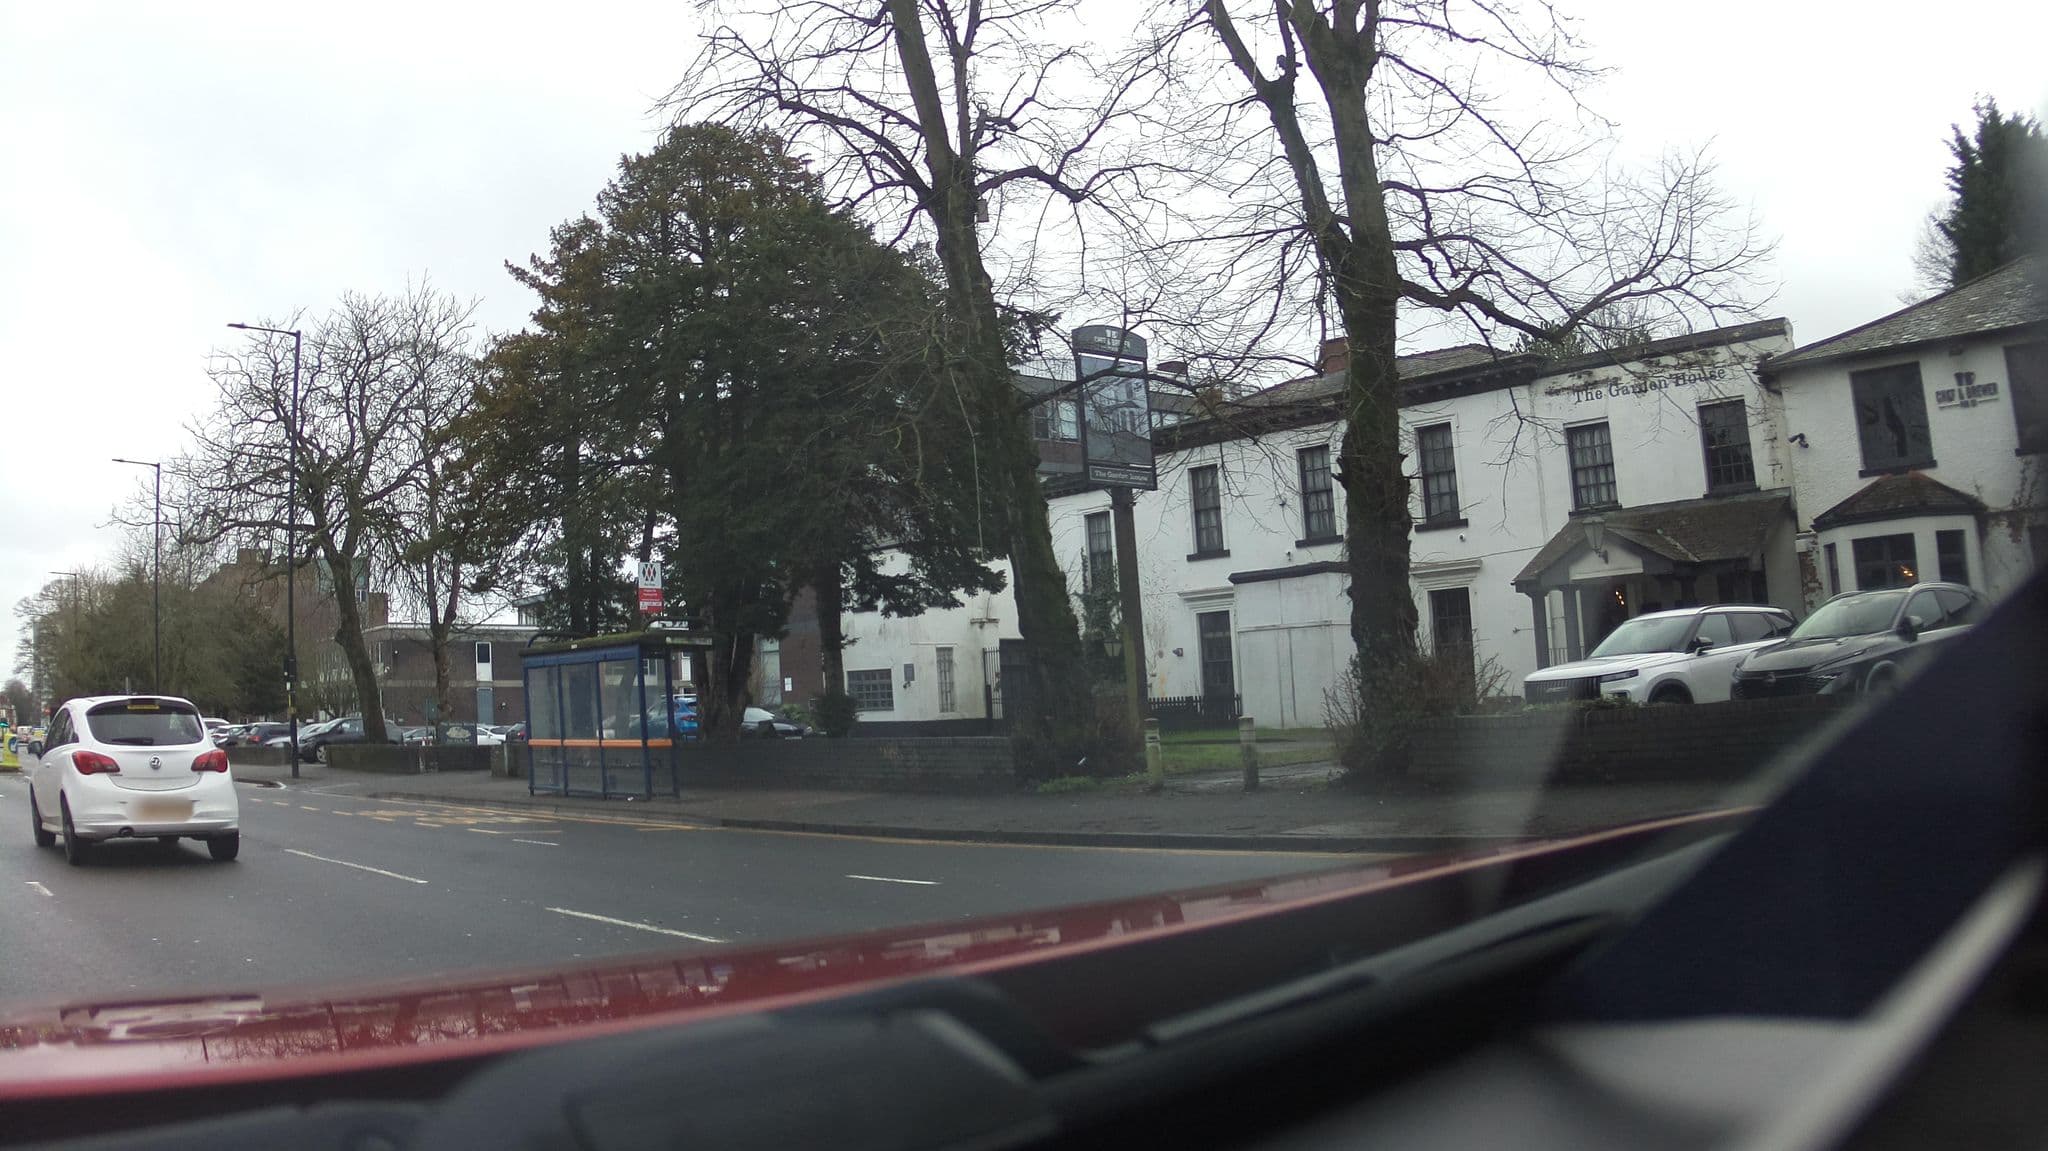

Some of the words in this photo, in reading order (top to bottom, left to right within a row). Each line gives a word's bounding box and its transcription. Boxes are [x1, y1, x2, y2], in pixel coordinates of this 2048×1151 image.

[1573, 389, 1603, 405] The
[1609, 378, 1668, 398] Garden
[1670, 368, 1726, 387] House
